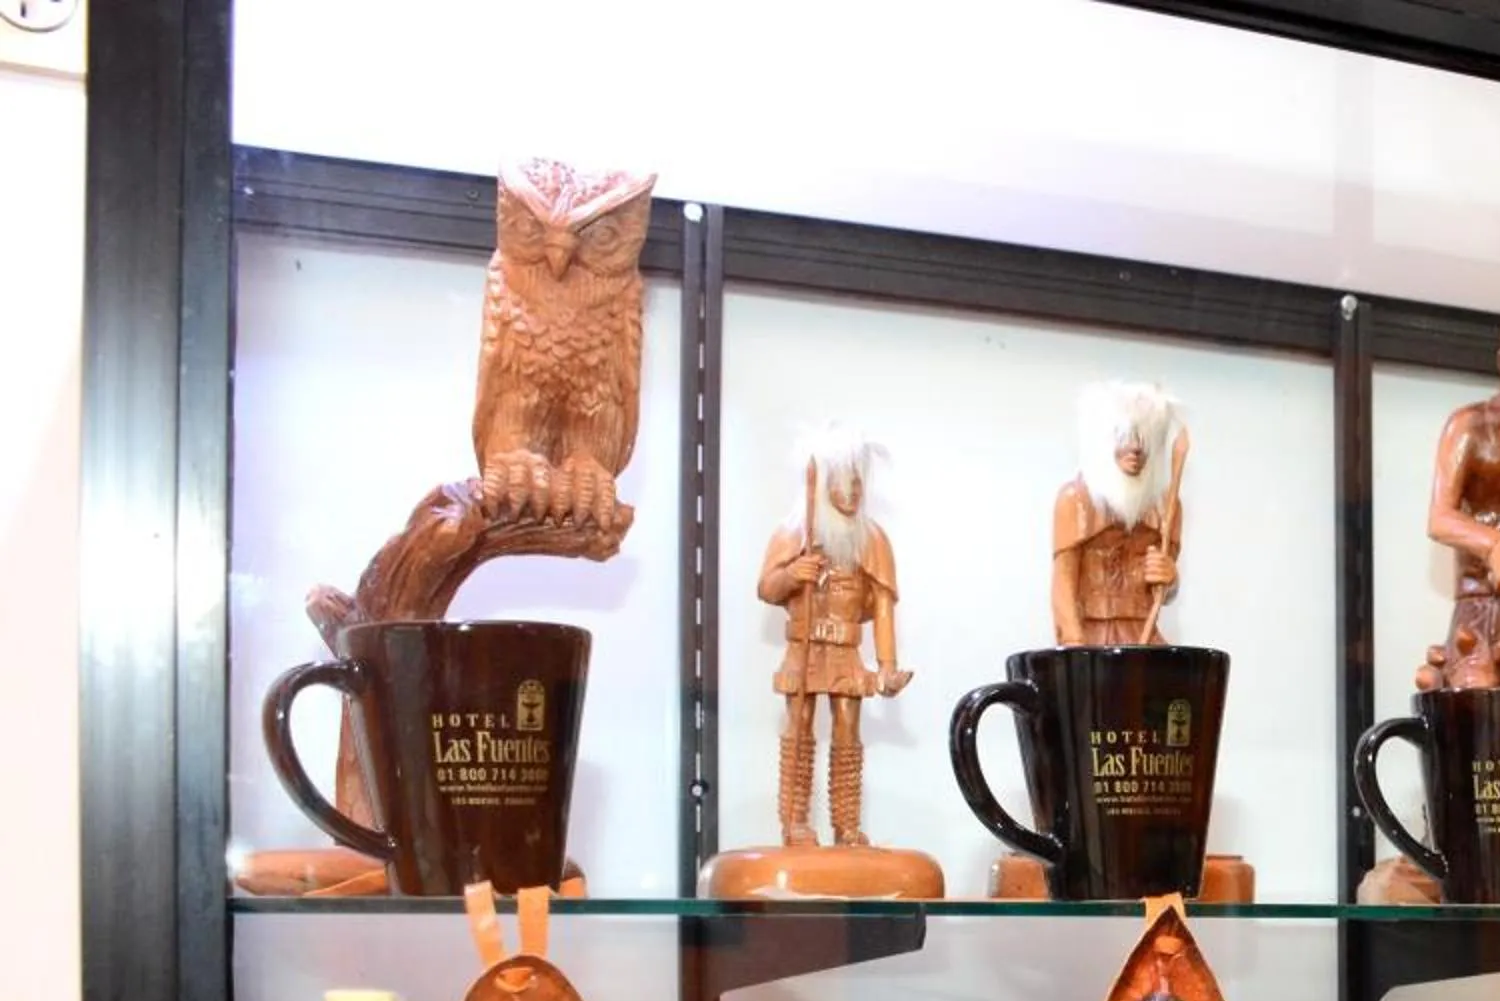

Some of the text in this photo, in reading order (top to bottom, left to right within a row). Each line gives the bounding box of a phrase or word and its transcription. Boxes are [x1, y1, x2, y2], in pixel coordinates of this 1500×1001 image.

[432, 713, 511, 729] HOTEL
[1090, 731, 1159, 745] HOTEL
[432, 731, 552, 764] Las Fuentes
[1091, 746, 1194, 777] Las Fuentes
[436, 767, 454, 782] 01
[459, 767, 487, 782] 800
[492, 768, 517, 782] 714
[1114, 780, 1139, 793] 800
